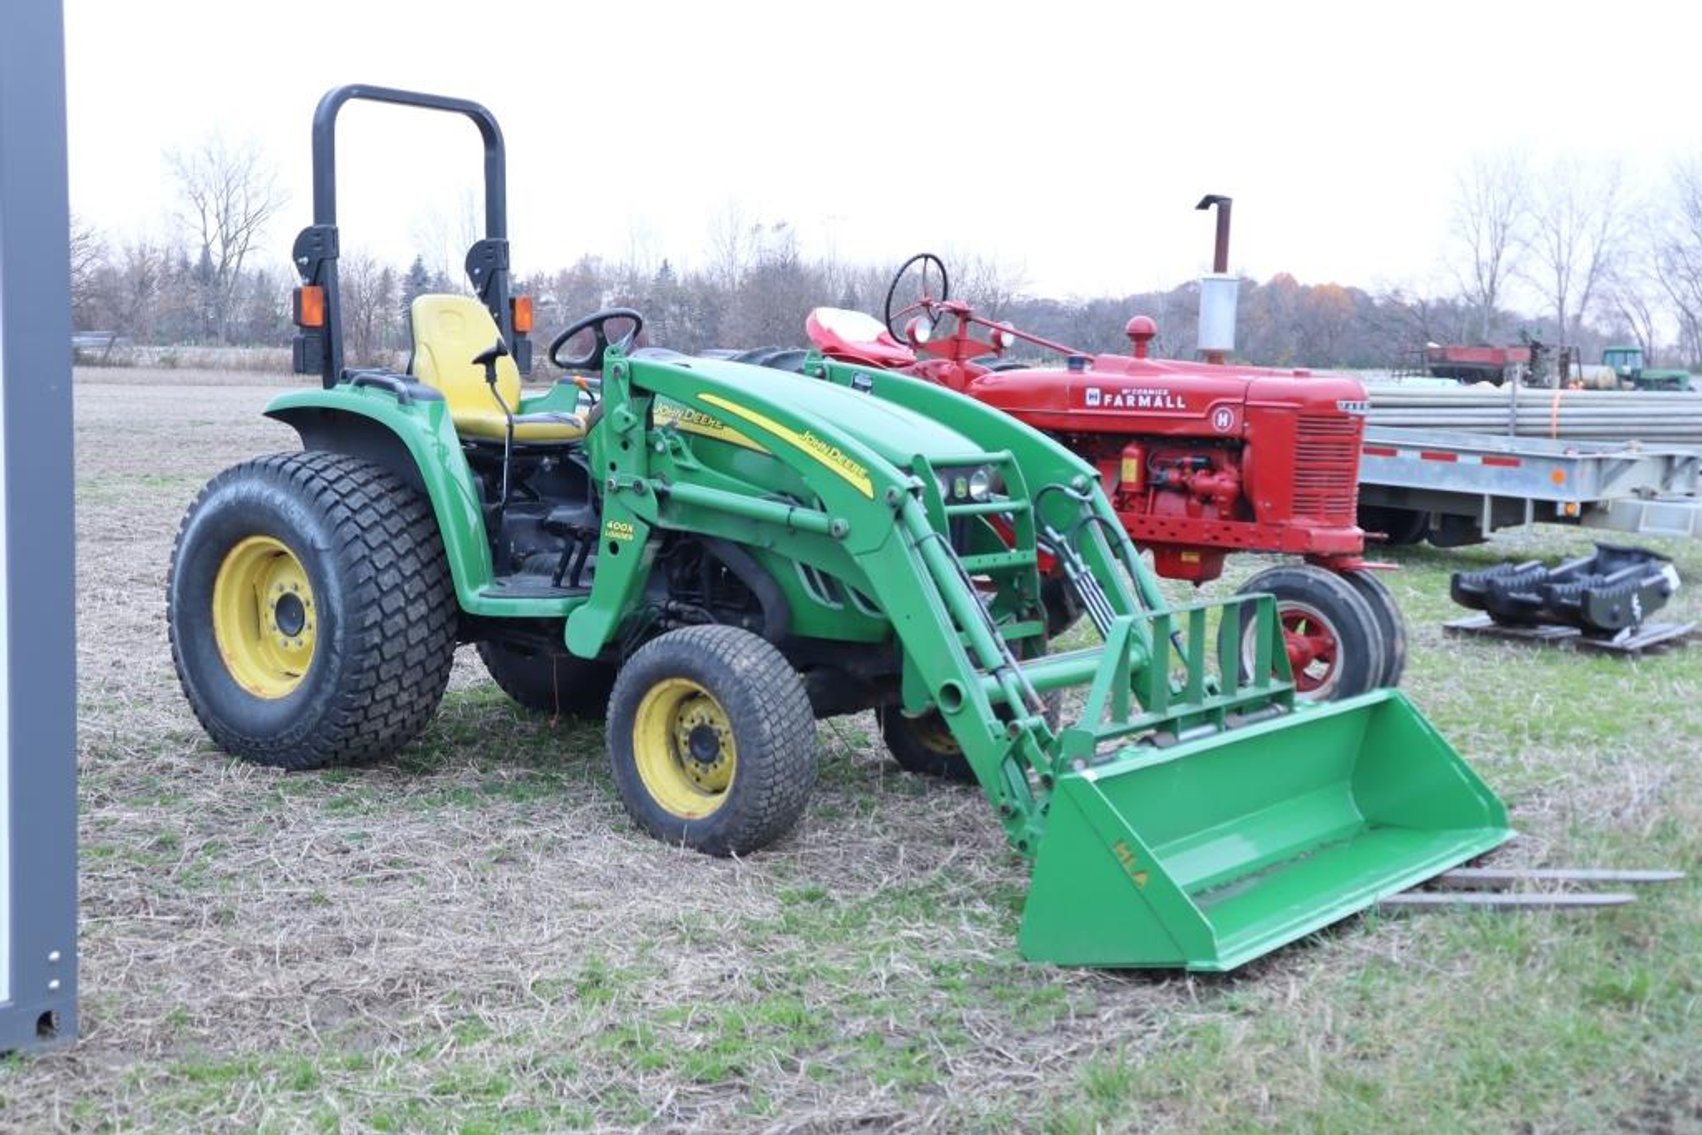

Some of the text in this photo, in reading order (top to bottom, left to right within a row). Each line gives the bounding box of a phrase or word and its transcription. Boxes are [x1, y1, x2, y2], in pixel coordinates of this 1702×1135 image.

[1103, 394, 1186, 409] FARMALL
[652, 402, 725, 430] JOHN DEERE
[1217, 412, 1229, 427] H
[799, 430, 868, 478] JOHN DEERE
[1113, 840, 1148, 889] HLA
